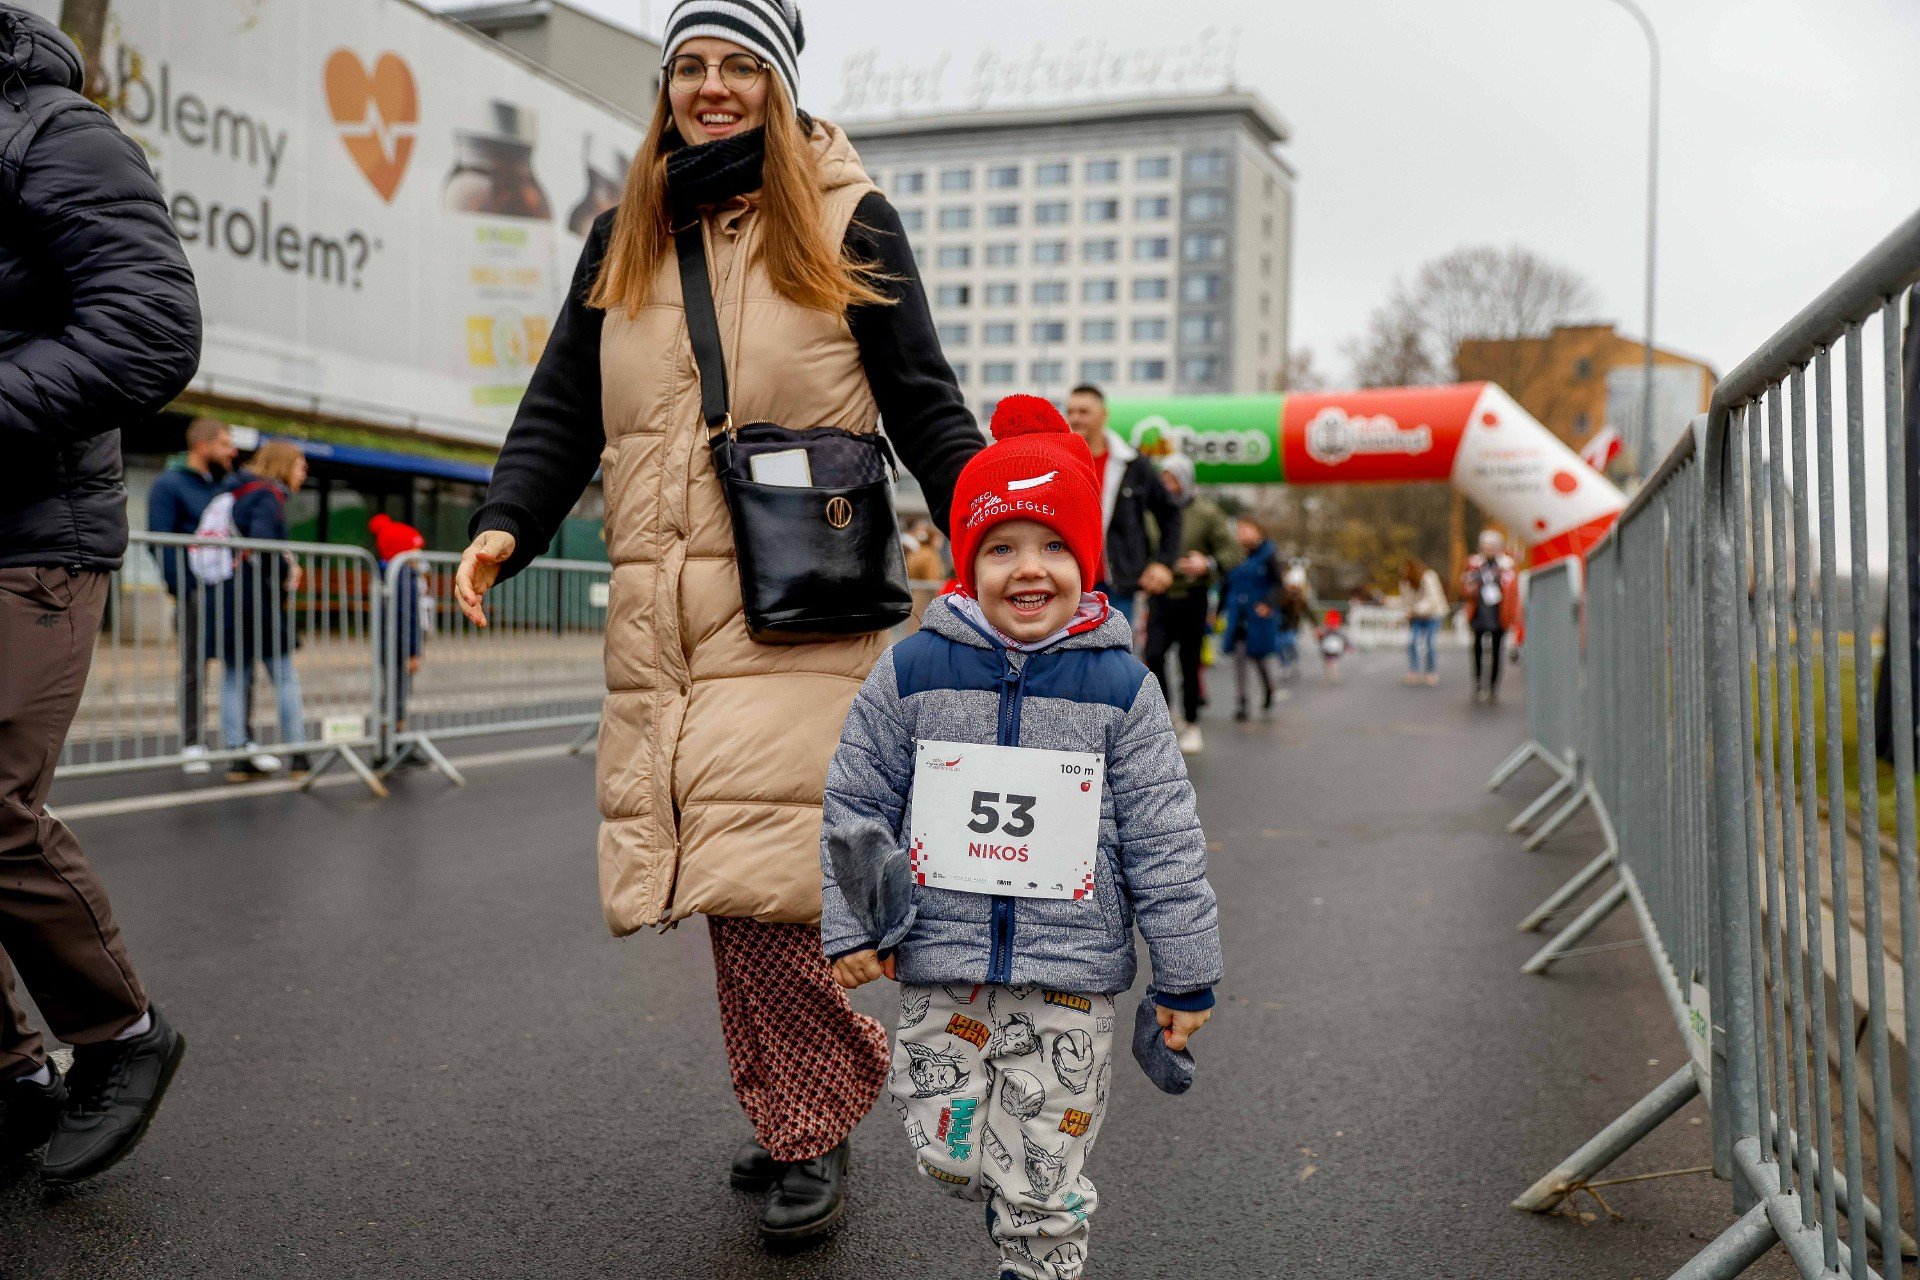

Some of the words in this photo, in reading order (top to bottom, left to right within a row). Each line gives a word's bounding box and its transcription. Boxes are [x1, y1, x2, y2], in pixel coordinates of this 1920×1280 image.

[154, 168, 369, 290] erolem?
[1061, 764, 1081, 775] 100
[1084, 767, 1094, 776] m
[967, 790, 1037, 838] 53
[968, 842, 1029, 863] NIKOŚ
[949, 1013, 992, 1040] IRON
[946, 1097, 978, 1162] HULK
